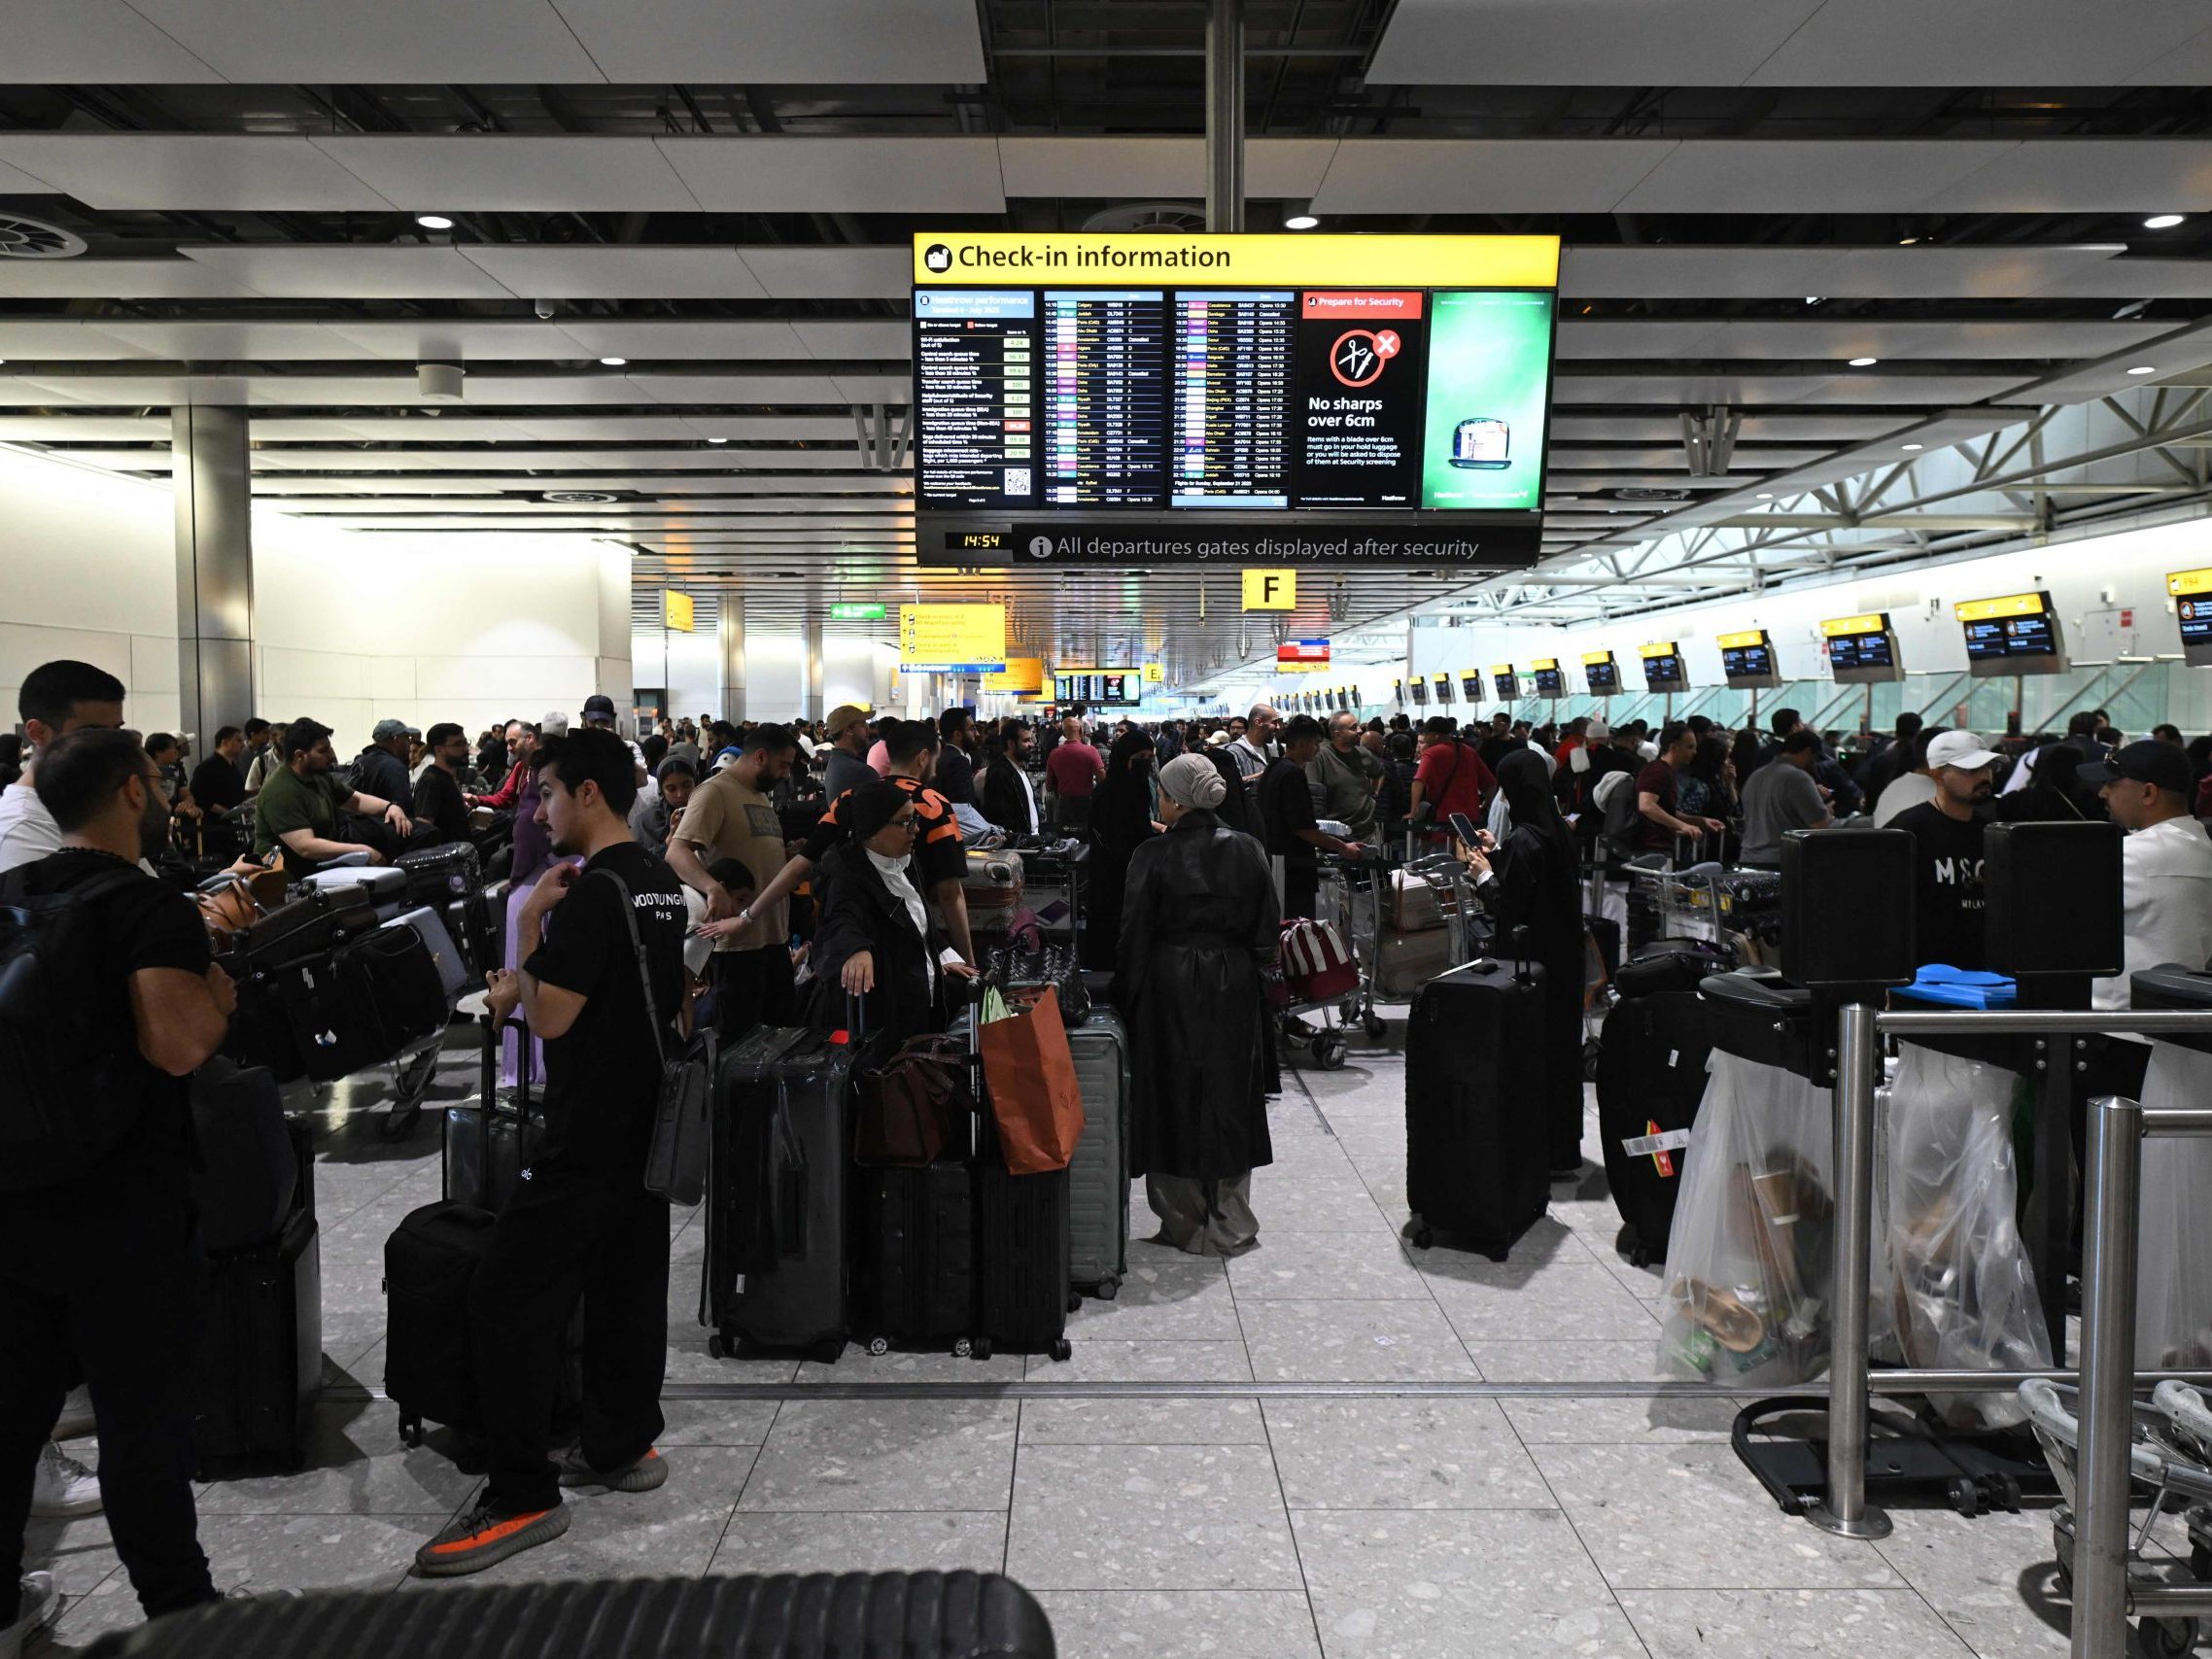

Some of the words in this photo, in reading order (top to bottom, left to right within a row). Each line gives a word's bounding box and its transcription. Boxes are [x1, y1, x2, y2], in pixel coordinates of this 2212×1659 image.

[959, 245, 1067, 266] Check-in
[1078, 245, 1229, 266] information
[1319, 298, 1352, 307] Prepare
[1369, 298, 1403, 307] Security
[1309, 397, 1330, 409] No
[1333, 397, 1382, 413] sharps
[1308, 417, 1342, 427] over
[1345, 414, 1374, 427] 6cm
[965, 536, 999, 547] 14:54
[1057, 537, 1080, 553] All
[1088, 537, 1192, 557] departures
[1197, 541, 1249, 558] gates
[1256, 538, 1347, 559] displayed
[1353, 538, 1398, 555] after
[1403, 539, 1478, 559] security
[1264, 576, 1279, 603] F
[1152, 670, 1157, 678] E
